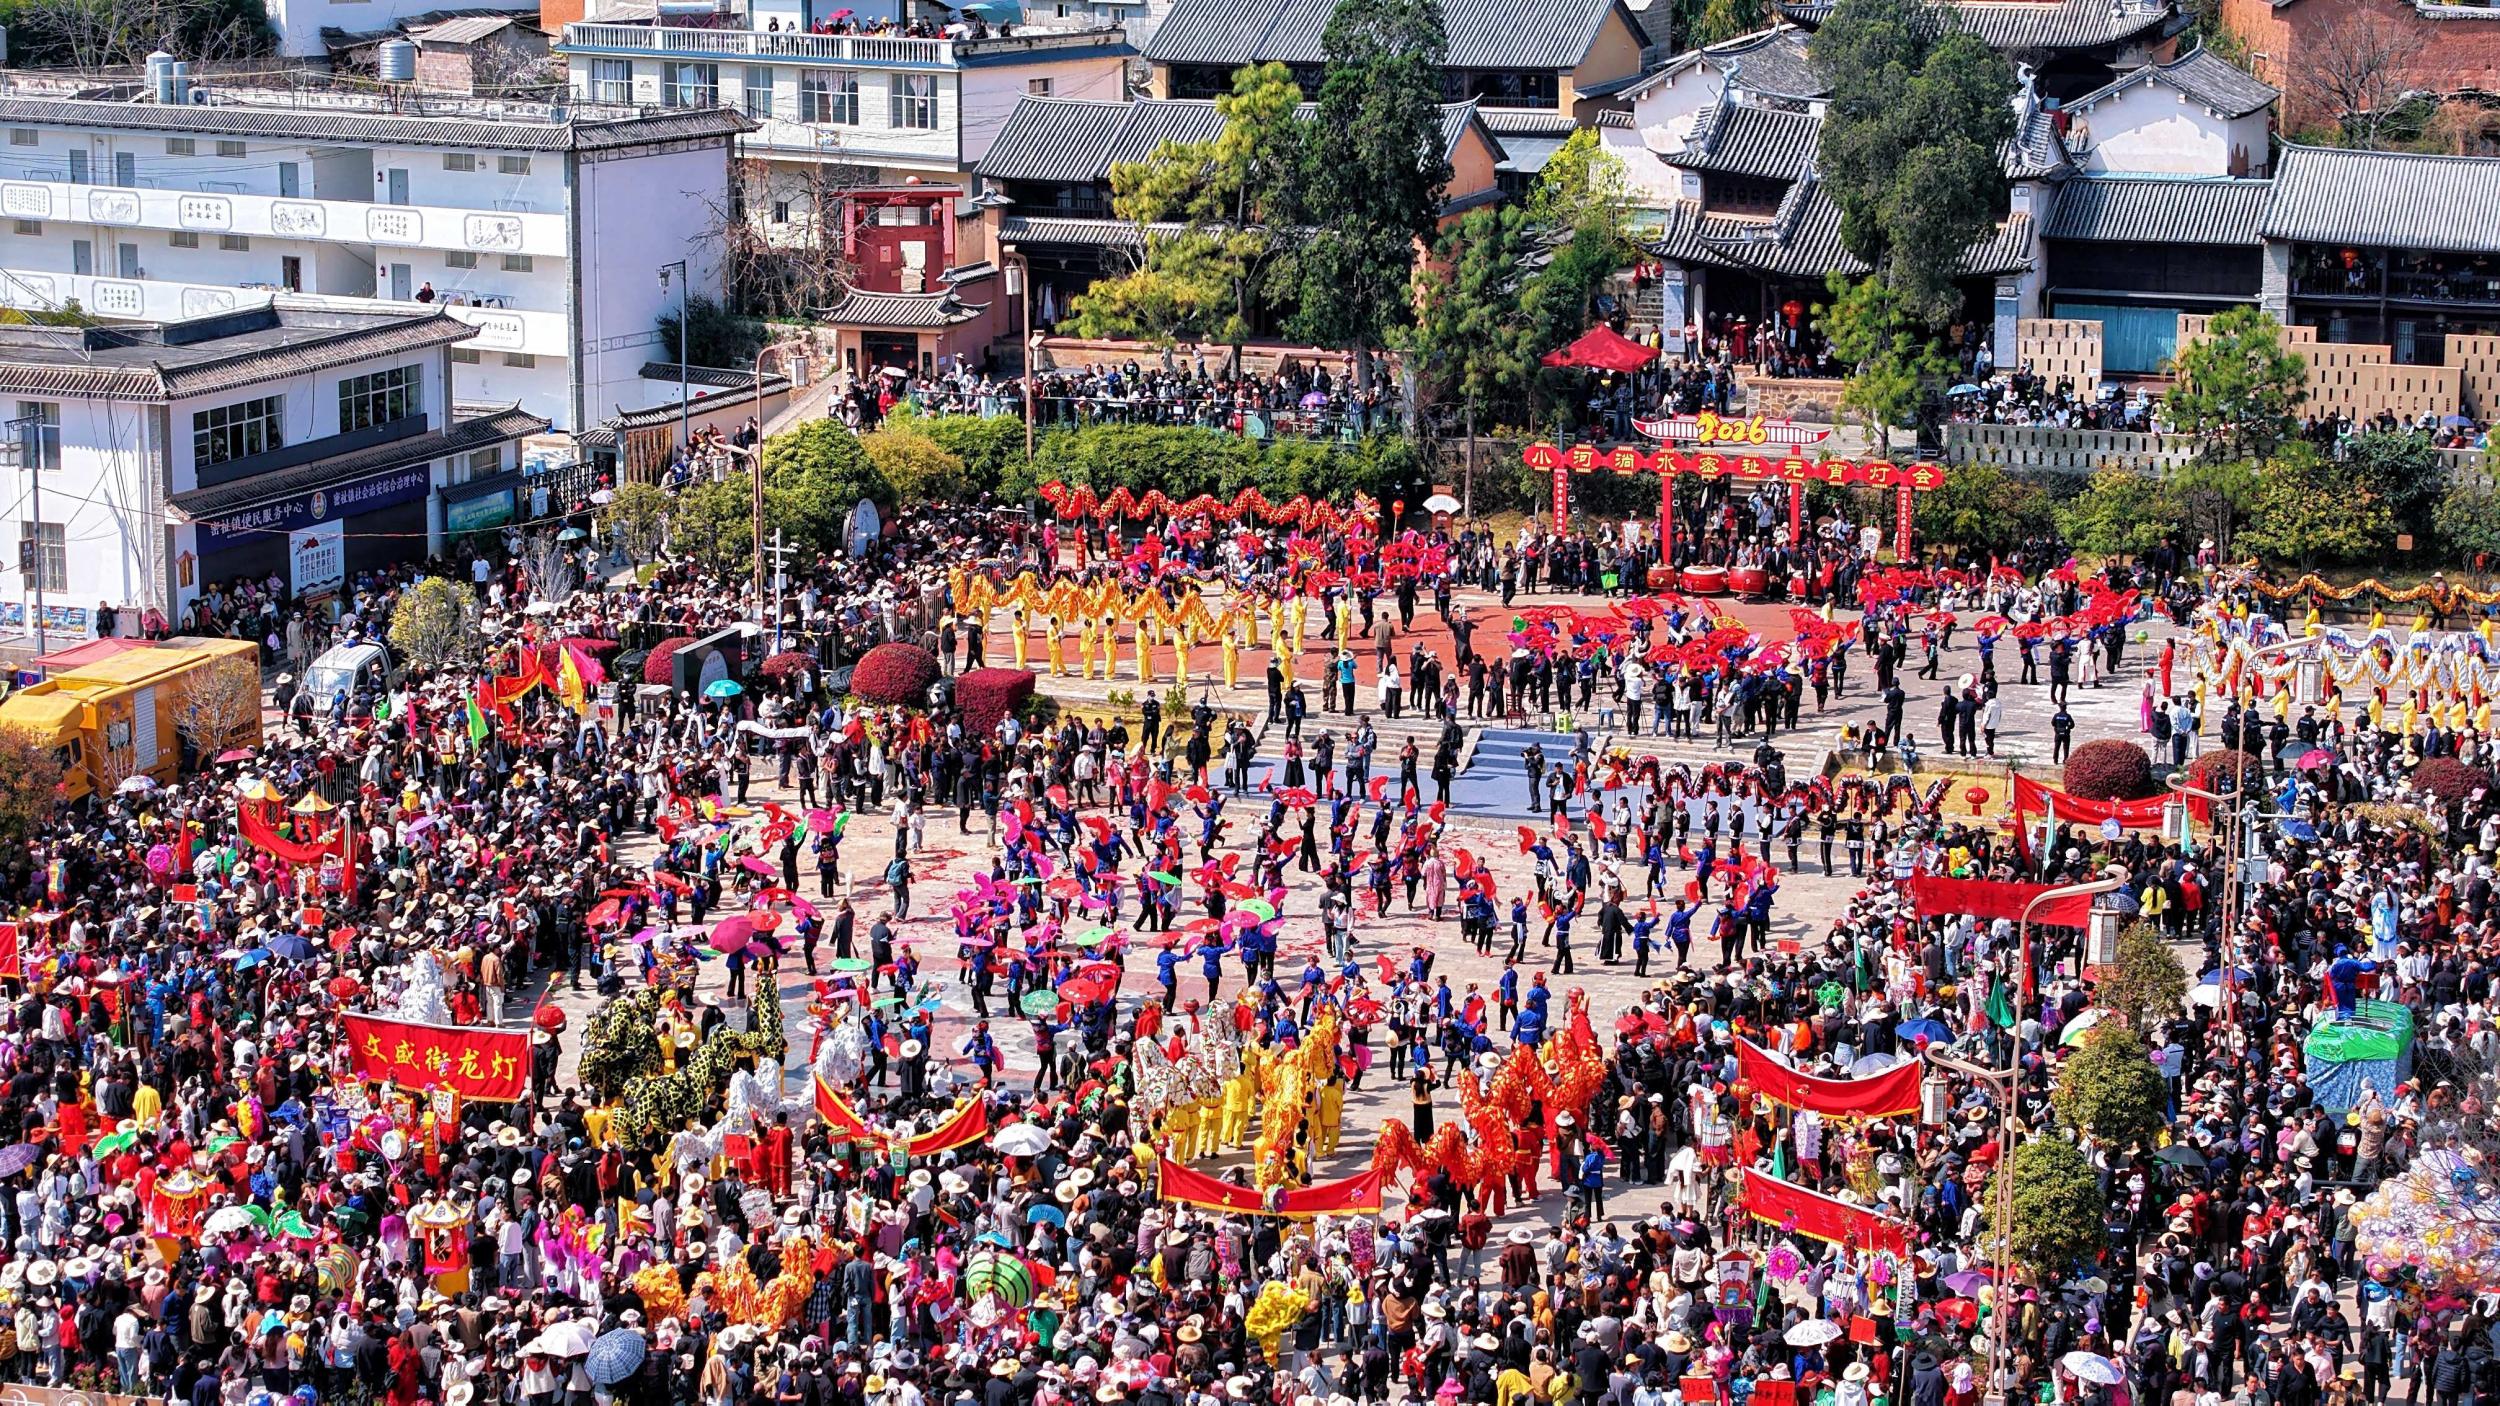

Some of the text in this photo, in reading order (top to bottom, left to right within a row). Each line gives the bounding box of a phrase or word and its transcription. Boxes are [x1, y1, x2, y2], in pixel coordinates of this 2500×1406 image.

[1695, 411, 1767, 445] 2026
[1532, 449, 1935, 485] 小河淌水密祉元宵灯会
[333, 472, 424, 507] 密祉镇社会治安综合治理中心
[210, 502, 304, 536] 密祉镇便民服务中心
[362, 1032, 517, 1081] 文盛街龙灯
